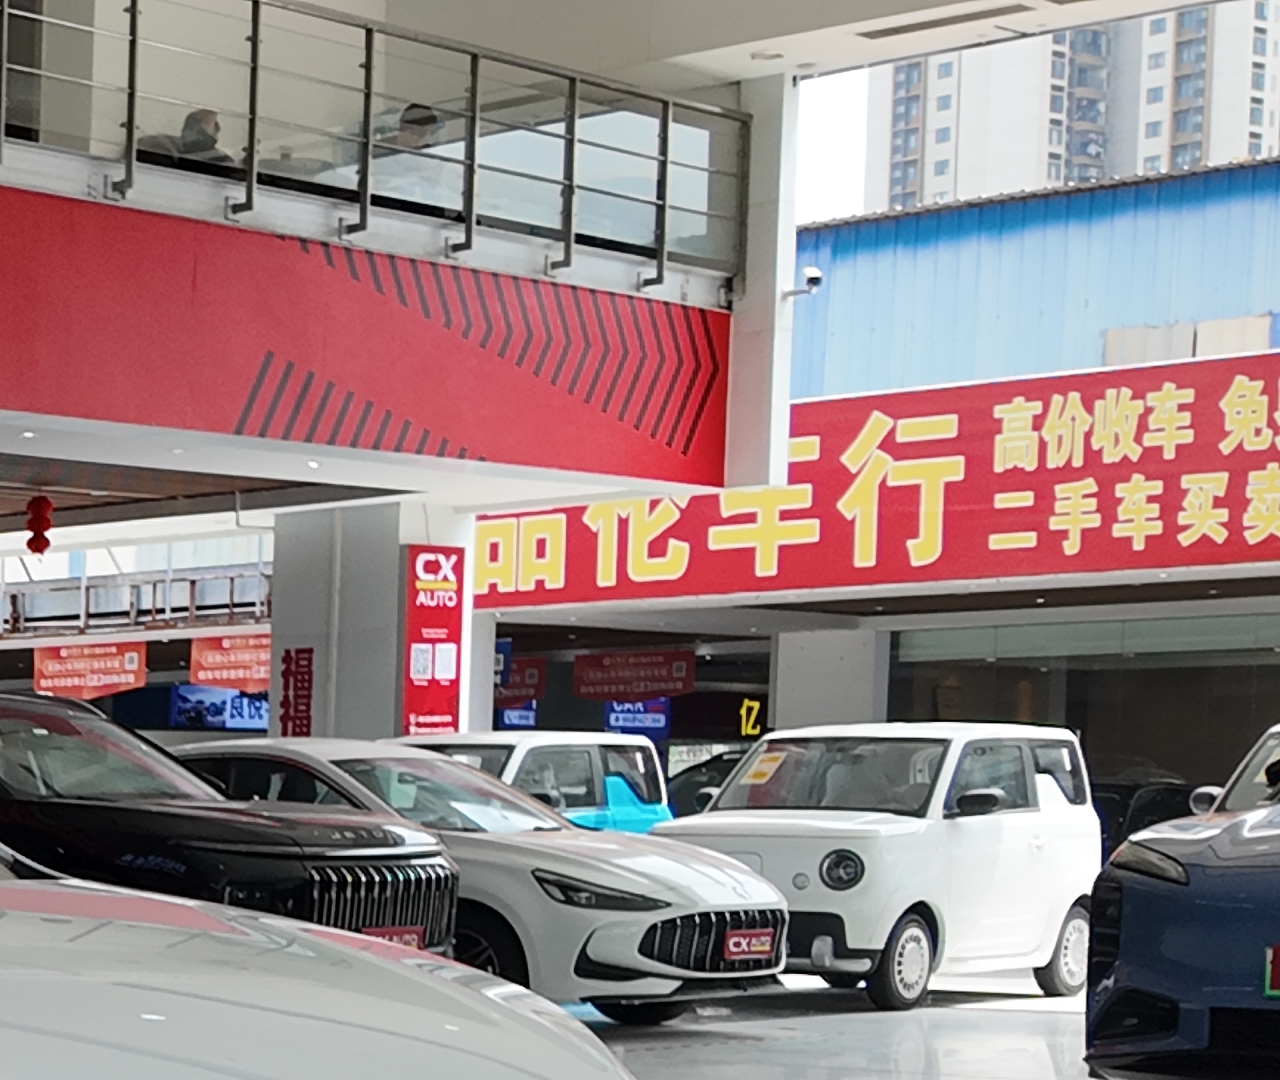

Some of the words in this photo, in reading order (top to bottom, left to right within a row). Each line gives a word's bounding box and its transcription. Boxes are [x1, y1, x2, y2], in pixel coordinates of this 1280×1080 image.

[993, 381, 1195, 473] 高价收车
[1218, 374, 1280, 456] 免
[988, 461, 1280, 556] 二手车买卖
[415, 553, 458, 582] CX
[415, 591, 457, 608] AUTO
[728, 936, 750, 953] CX
